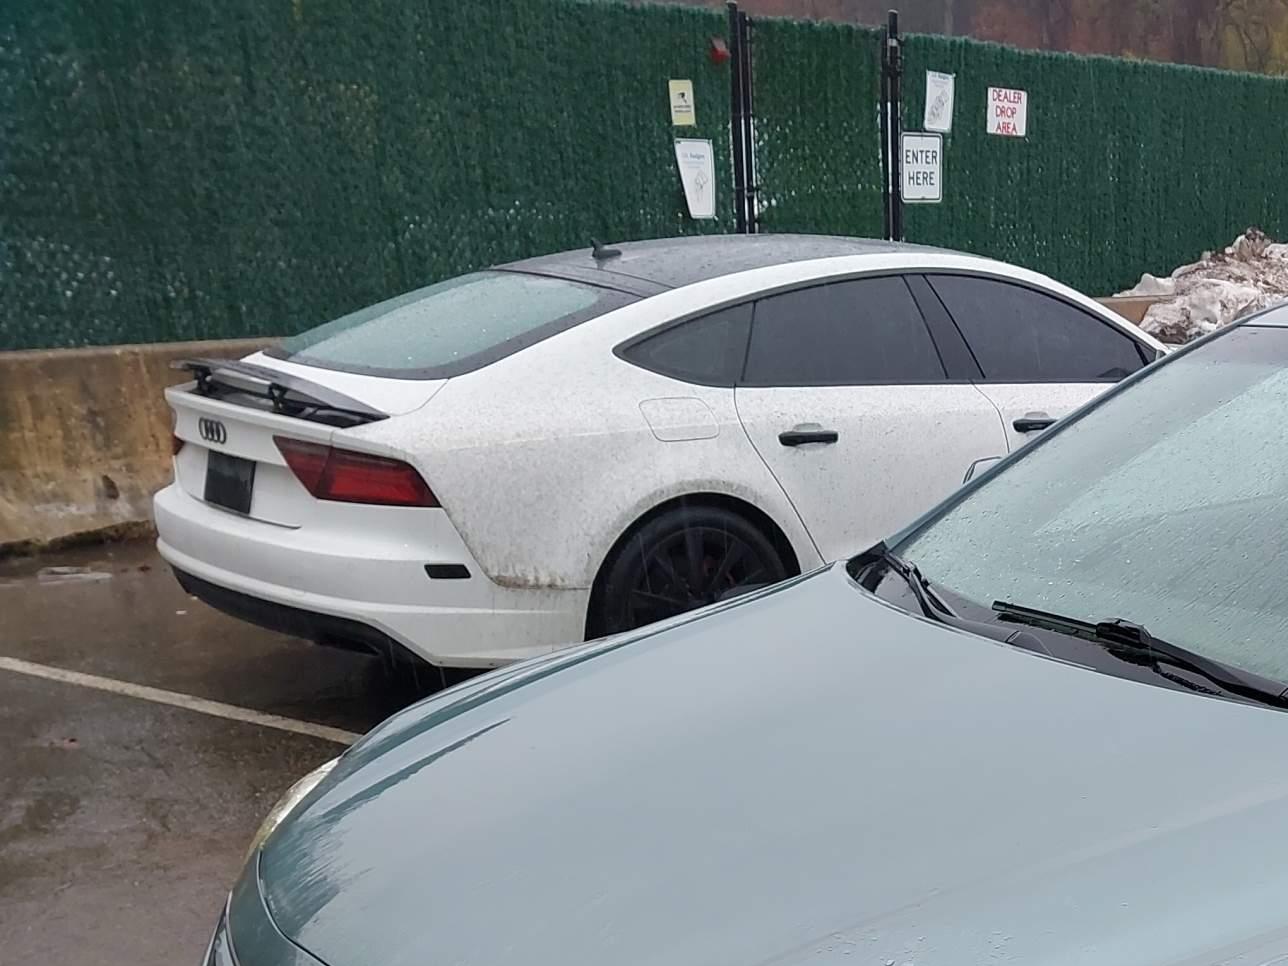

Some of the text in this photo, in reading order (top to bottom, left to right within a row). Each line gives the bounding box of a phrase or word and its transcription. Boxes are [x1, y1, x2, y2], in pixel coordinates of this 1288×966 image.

[992, 88, 1022, 104] DEALER
[995, 105, 1017, 119] DROP
[995, 121, 1018, 135] AREA
[905, 149, 938, 165] ENTER
[908, 171, 935, 186] HERE
